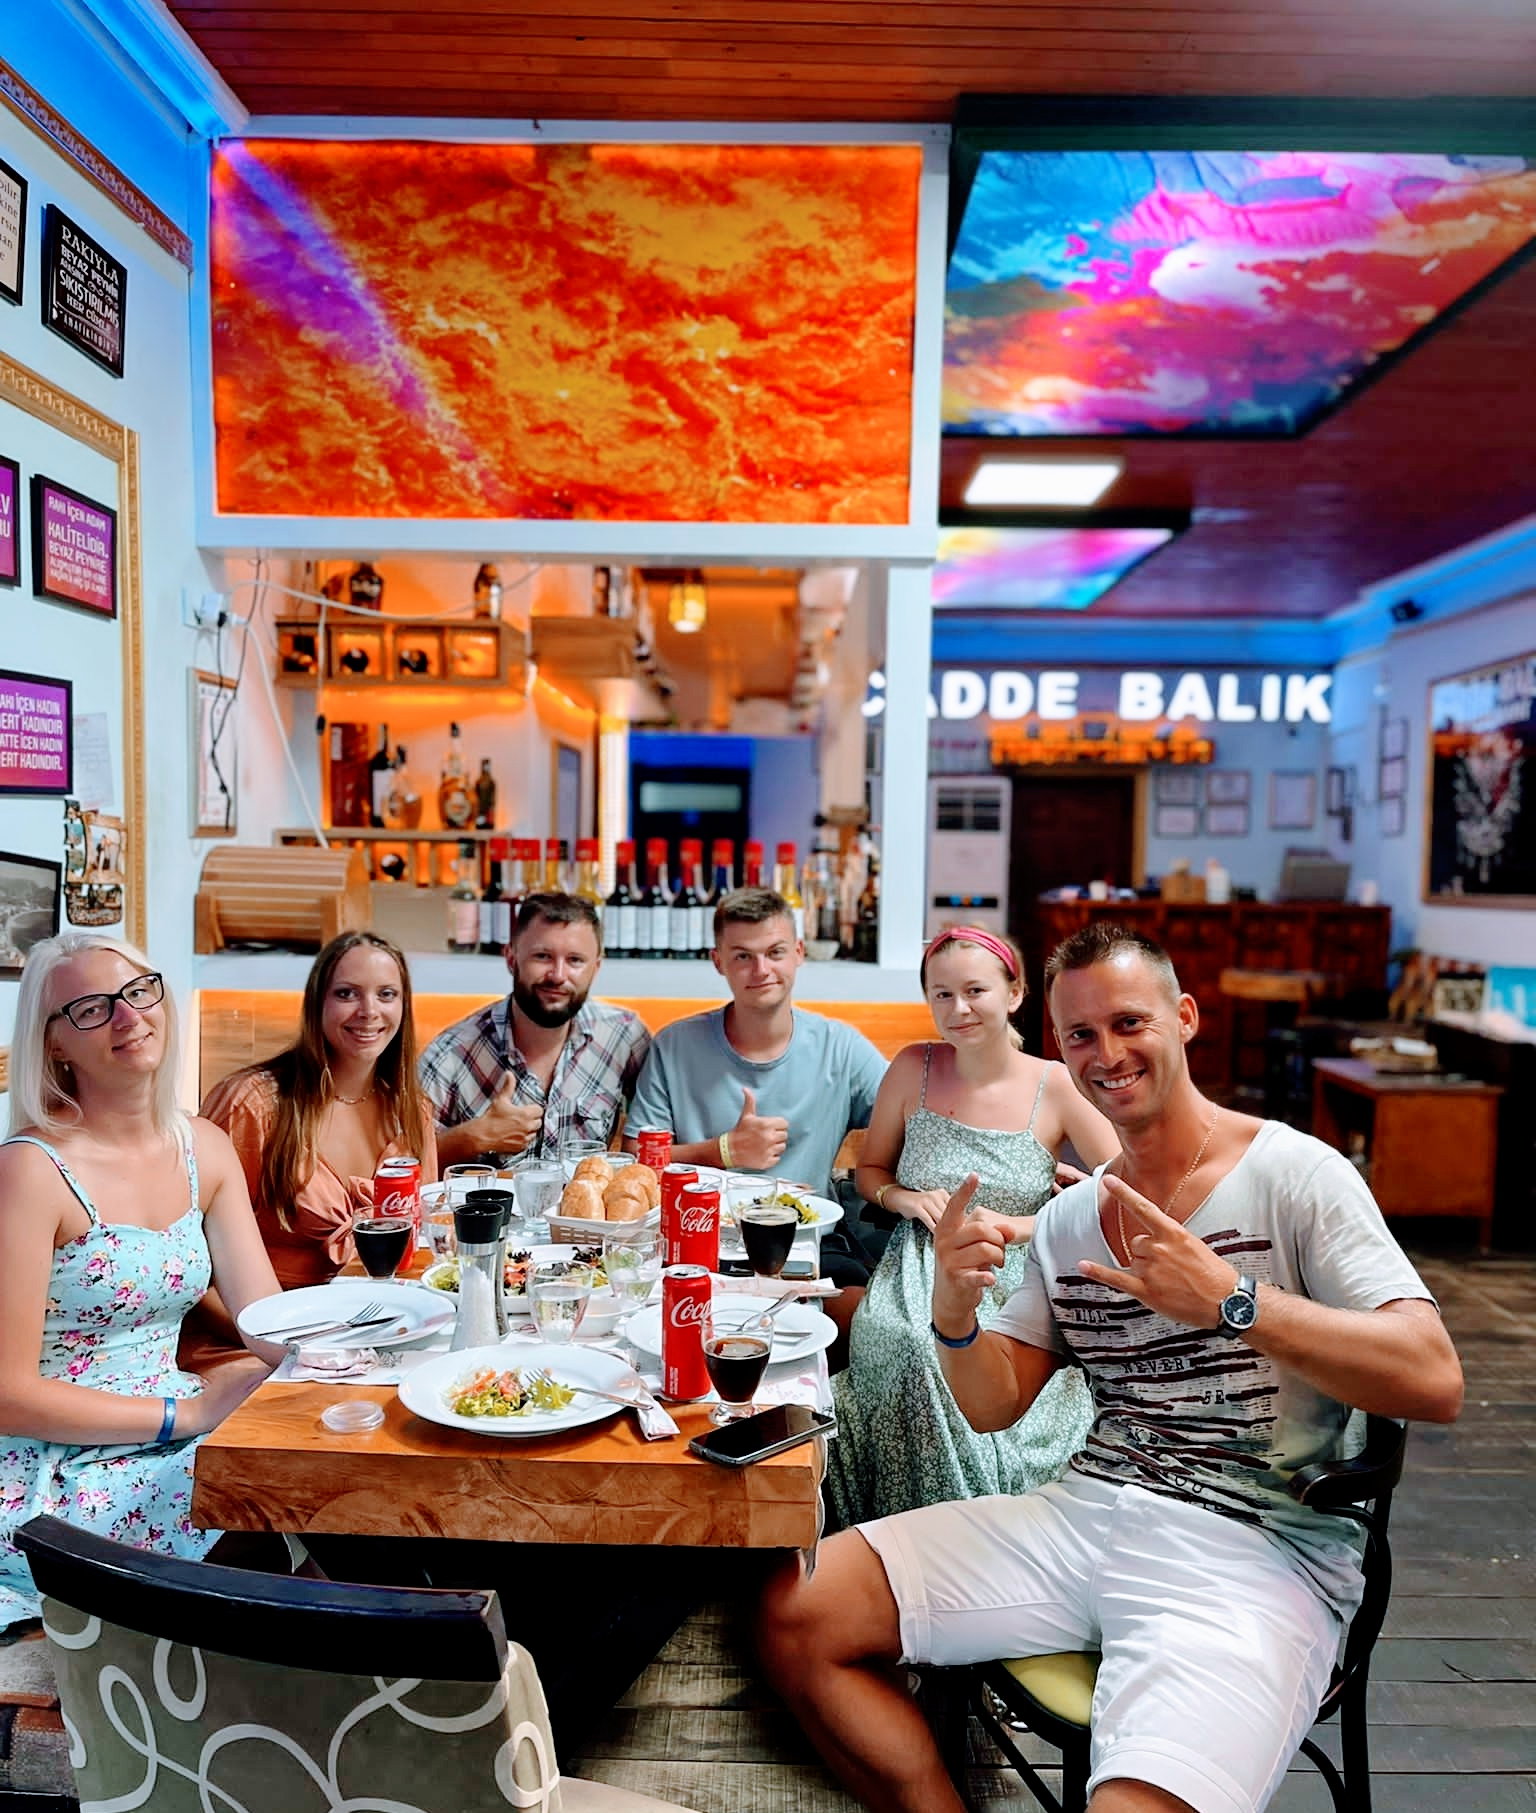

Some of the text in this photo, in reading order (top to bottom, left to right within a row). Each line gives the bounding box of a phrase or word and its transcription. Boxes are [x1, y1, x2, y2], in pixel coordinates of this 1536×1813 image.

[61, 244, 89, 276] BEYAZ
[62, 224, 119, 286] RAKIYLA
[66, 293, 85, 315] HER
[48, 540, 74, 561] BEYAZ
[1119, 671, 1332, 722] BALIK
[0, 712, 19, 730] ERT
[680, 1206, 718, 1233] Cola
[670, 1296, 712, 1328] Coca
[1120, 1358, 1185, 1374] NEVER
